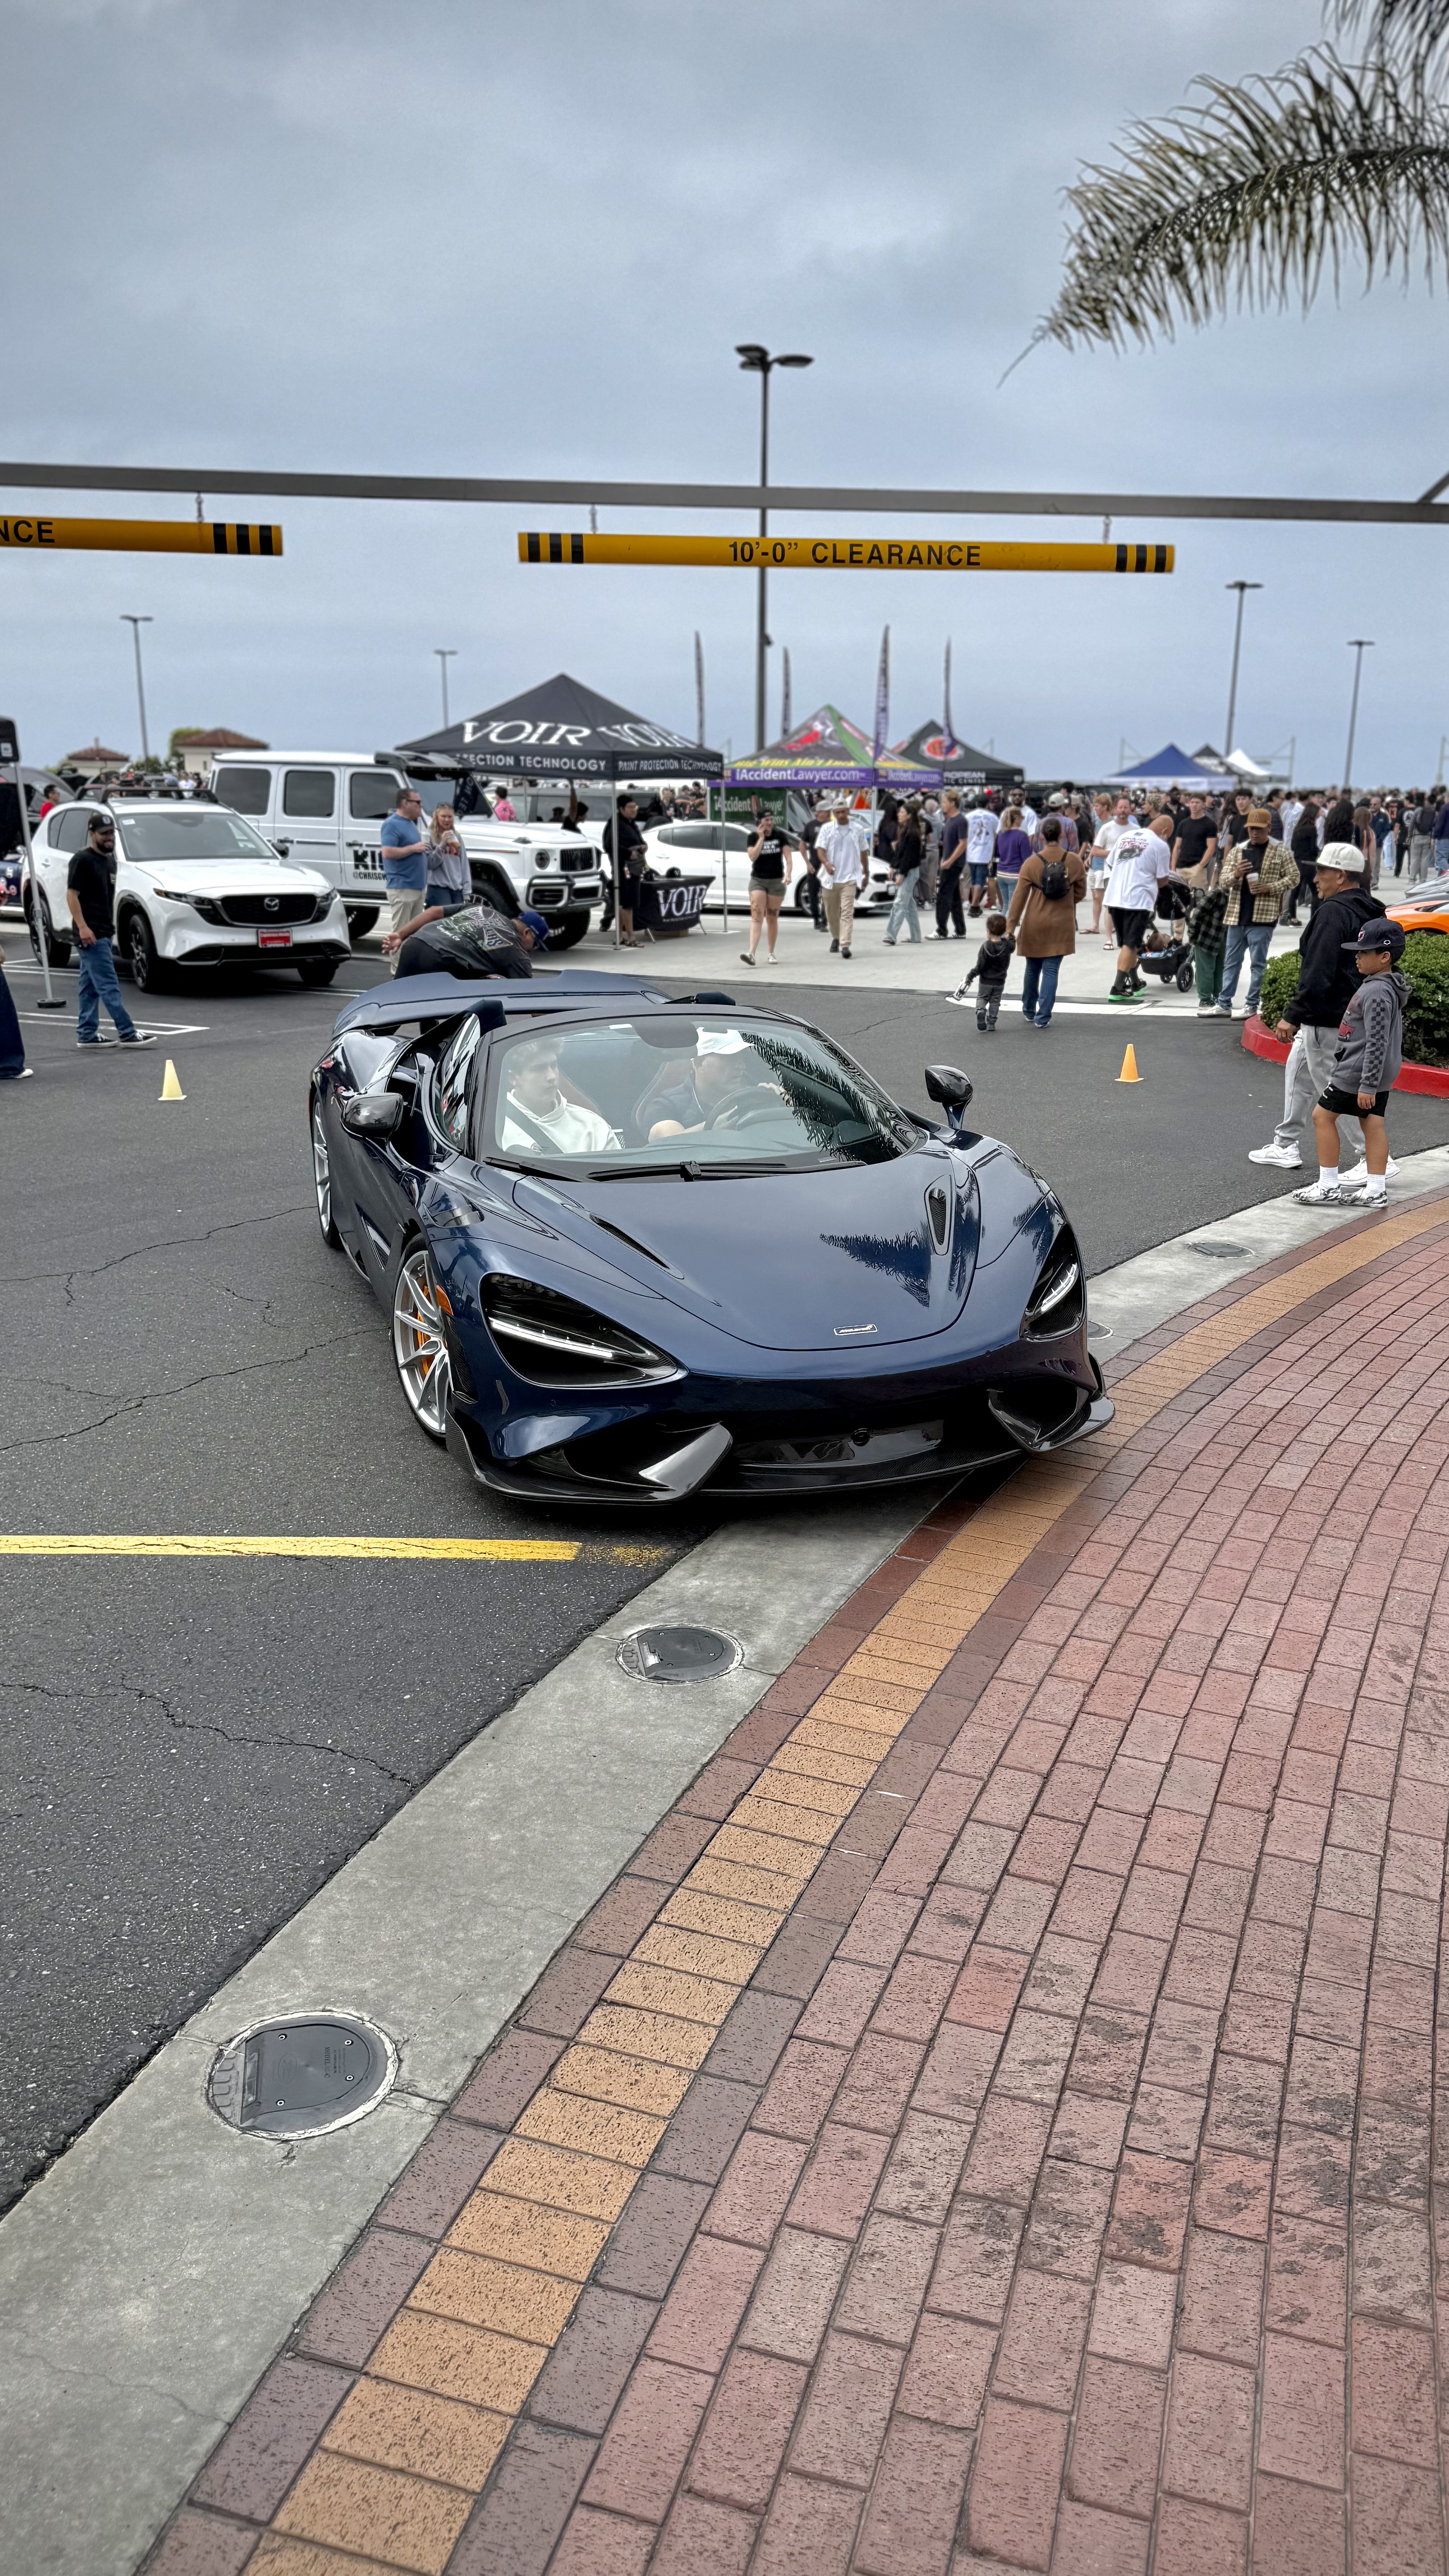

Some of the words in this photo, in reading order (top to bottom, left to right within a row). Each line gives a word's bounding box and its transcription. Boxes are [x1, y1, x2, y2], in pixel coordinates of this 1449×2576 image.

[812, 543, 981, 566] CLEARANCE
[463, 720, 592, 746] VOIR
[520, 756, 606, 771] TECHNOLOGY
[618, 761, 638, 771] PAINT
[640, 759, 678, 771] PROTECTION
[760, 758, 789, 766] Wins
[736, 768, 859, 783] iAccidentLawyer.com
[657, 885, 707, 916] VOIR
